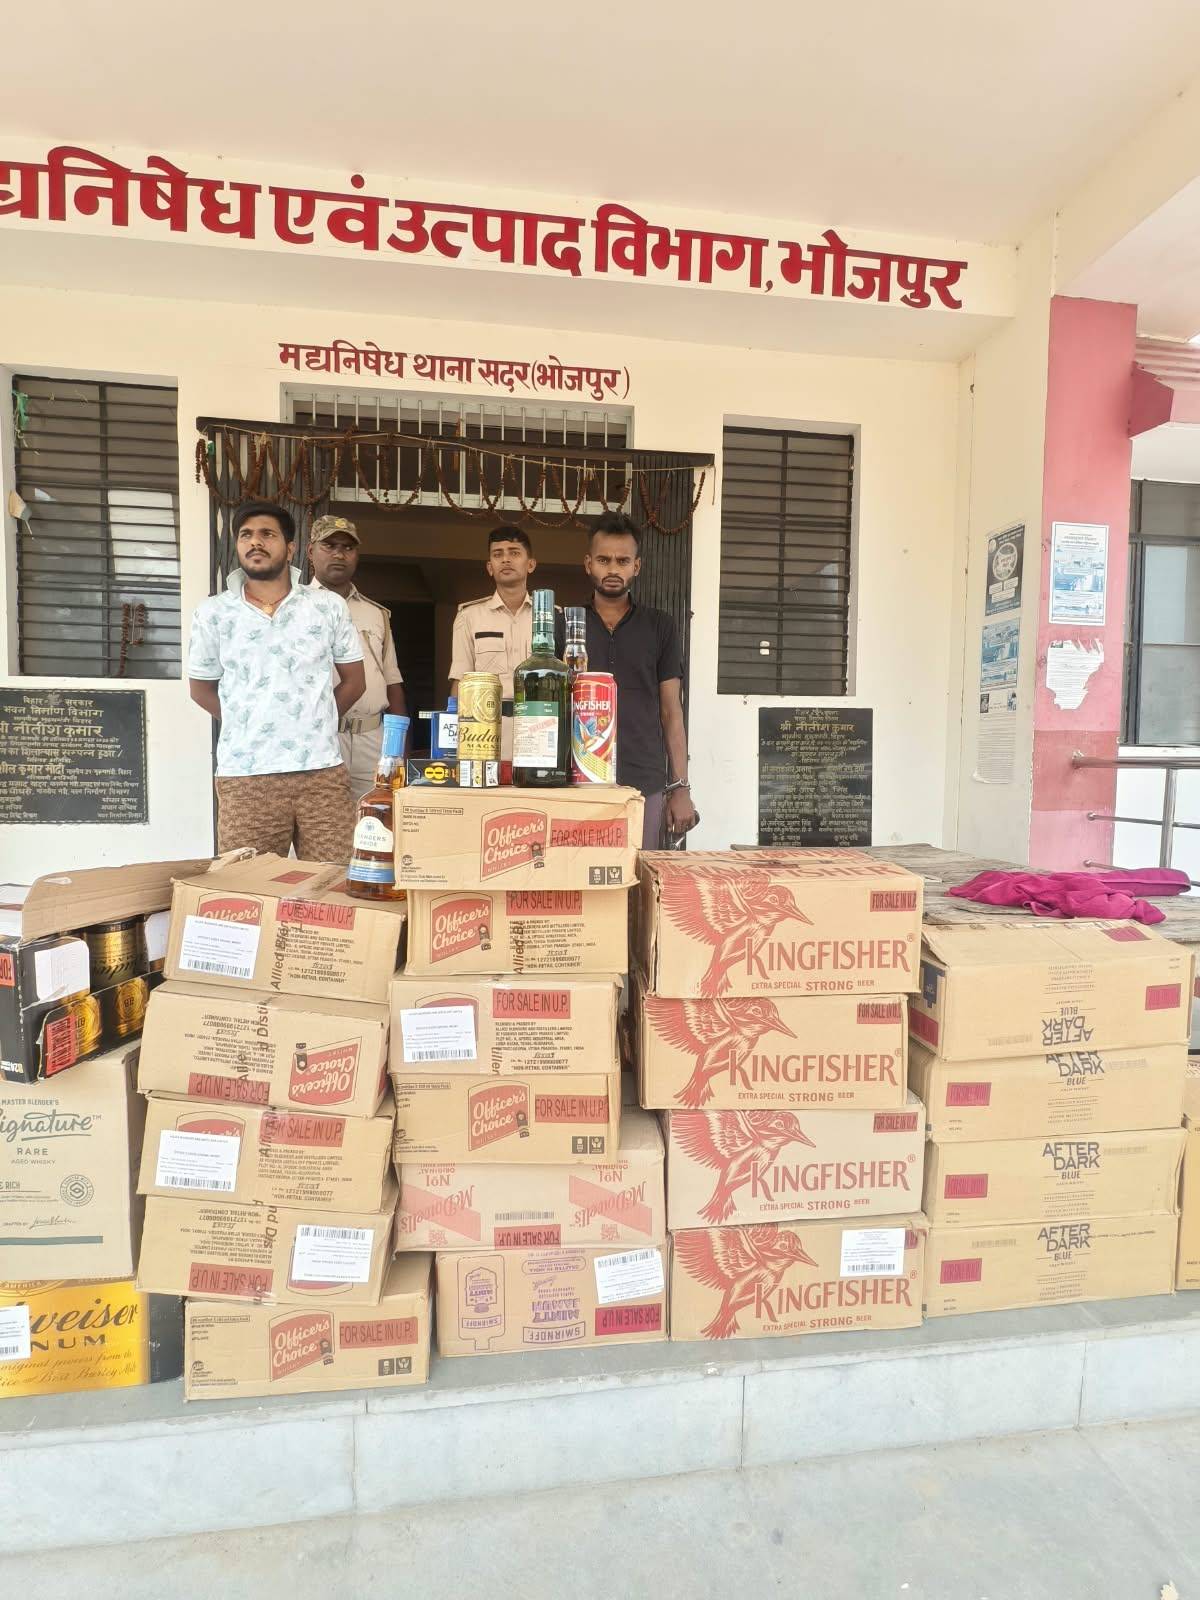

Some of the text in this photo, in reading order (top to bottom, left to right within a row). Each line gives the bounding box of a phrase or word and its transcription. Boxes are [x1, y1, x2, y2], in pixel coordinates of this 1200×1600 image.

[269, 174, 389, 251] एवं
[388, 199, 586, 277] उत्पाद
[778, 229, 968, 309] भोजपुर
[279, 340, 407, 378] मद्यनिषेध
[413, 354, 475, 384] थाना
[478, 358, 530, 394] सदर
[488, 818, 545, 848] Officer's
[551, 829, 570, 847] FOR
[572, 829, 594, 846] SALE
[597, 829, 606, 846] IN
[484, 844, 529, 865] Choice
[885, 892, 898, 909] SALE
[435, 904, 489, 932] Officer's
[433, 927, 475, 949] Choice
[745, 937, 911, 980] KINGFISHER
[751, 979, 875, 991] EXTRA SPECIAL STRONG BEER
[496, 992, 514, 1011] FOR
[516, 993, 540, 1012] SALE
[542, 994, 550, 1012] IN
[1060, 1007, 1079, 1016] BLUE
[1041, 1016, 1086, 1033] DARK
[1042, 1028, 1095, 1046] AFTER
[308, 1056, 354, 1074] Choice
[1045, 1050, 1100, 1064] AFTER
[729, 1049, 899, 1090] KINGFISHER
[1058, 1060, 1105, 1077] DARK
[291, 1073, 350, 1097] Officer's
[1066, 1077, 1087, 1086] BLUE
[474, 1089, 527, 1120] Officer's
[738, 1092, 758, 1100] EXTRA
[788, 1092, 834, 1102] STRONG
[838, 1091, 855, 1099] BEER
[536, 1099, 553, 1117] FOR
[555, 1098, 576, 1117] SALE
[579, 1099, 587, 1117] IN
[287, 1118, 310, 1139] SALE
[313, 1119, 323, 1140] IN
[472, 1115, 513, 1137] Choice
[17, 1147, 49, 1156] RARE
[1042, 1142, 1100, 1158] AFTER
[1053, 1155, 1100, 1170] DARK
[751, 1160, 911, 1201] KINGFISHER
[1061, 1171, 1081, 1179] BLUE
[759, 1203, 778, 1211] EXTRA
[779, 1202, 804, 1210] SPECIAL
[807, 1199, 850, 1211] STRONG
[512, 1233, 521, 1246] IN
[523, 1232, 542, 1246] SALE
[543, 1231, 560, 1246] FOR
[1037, 1223, 1091, 1240] AFTER
[1046, 1236, 1091, 1252] DARK
[1054, 1251, 1072, 1261] BLUE
[754, 1278, 912, 1322] KINGFISHER
[16, 1298, 138, 1335] weiser
[625, 1307, 644, 1325] SALE
[762, 1323, 782, 1332] EXTRA
[783, 1321, 806, 1330] SPECIAL
[810, 1316, 853, 1328] STRONG
[275, 1320, 330, 1348] Officer's
[340, 1326, 358, 1344] FOR
[361, 1325, 382, 1343] SALE
[385, 1324, 394, 1341] IN
[273, 1345, 317, 1367] Choice
